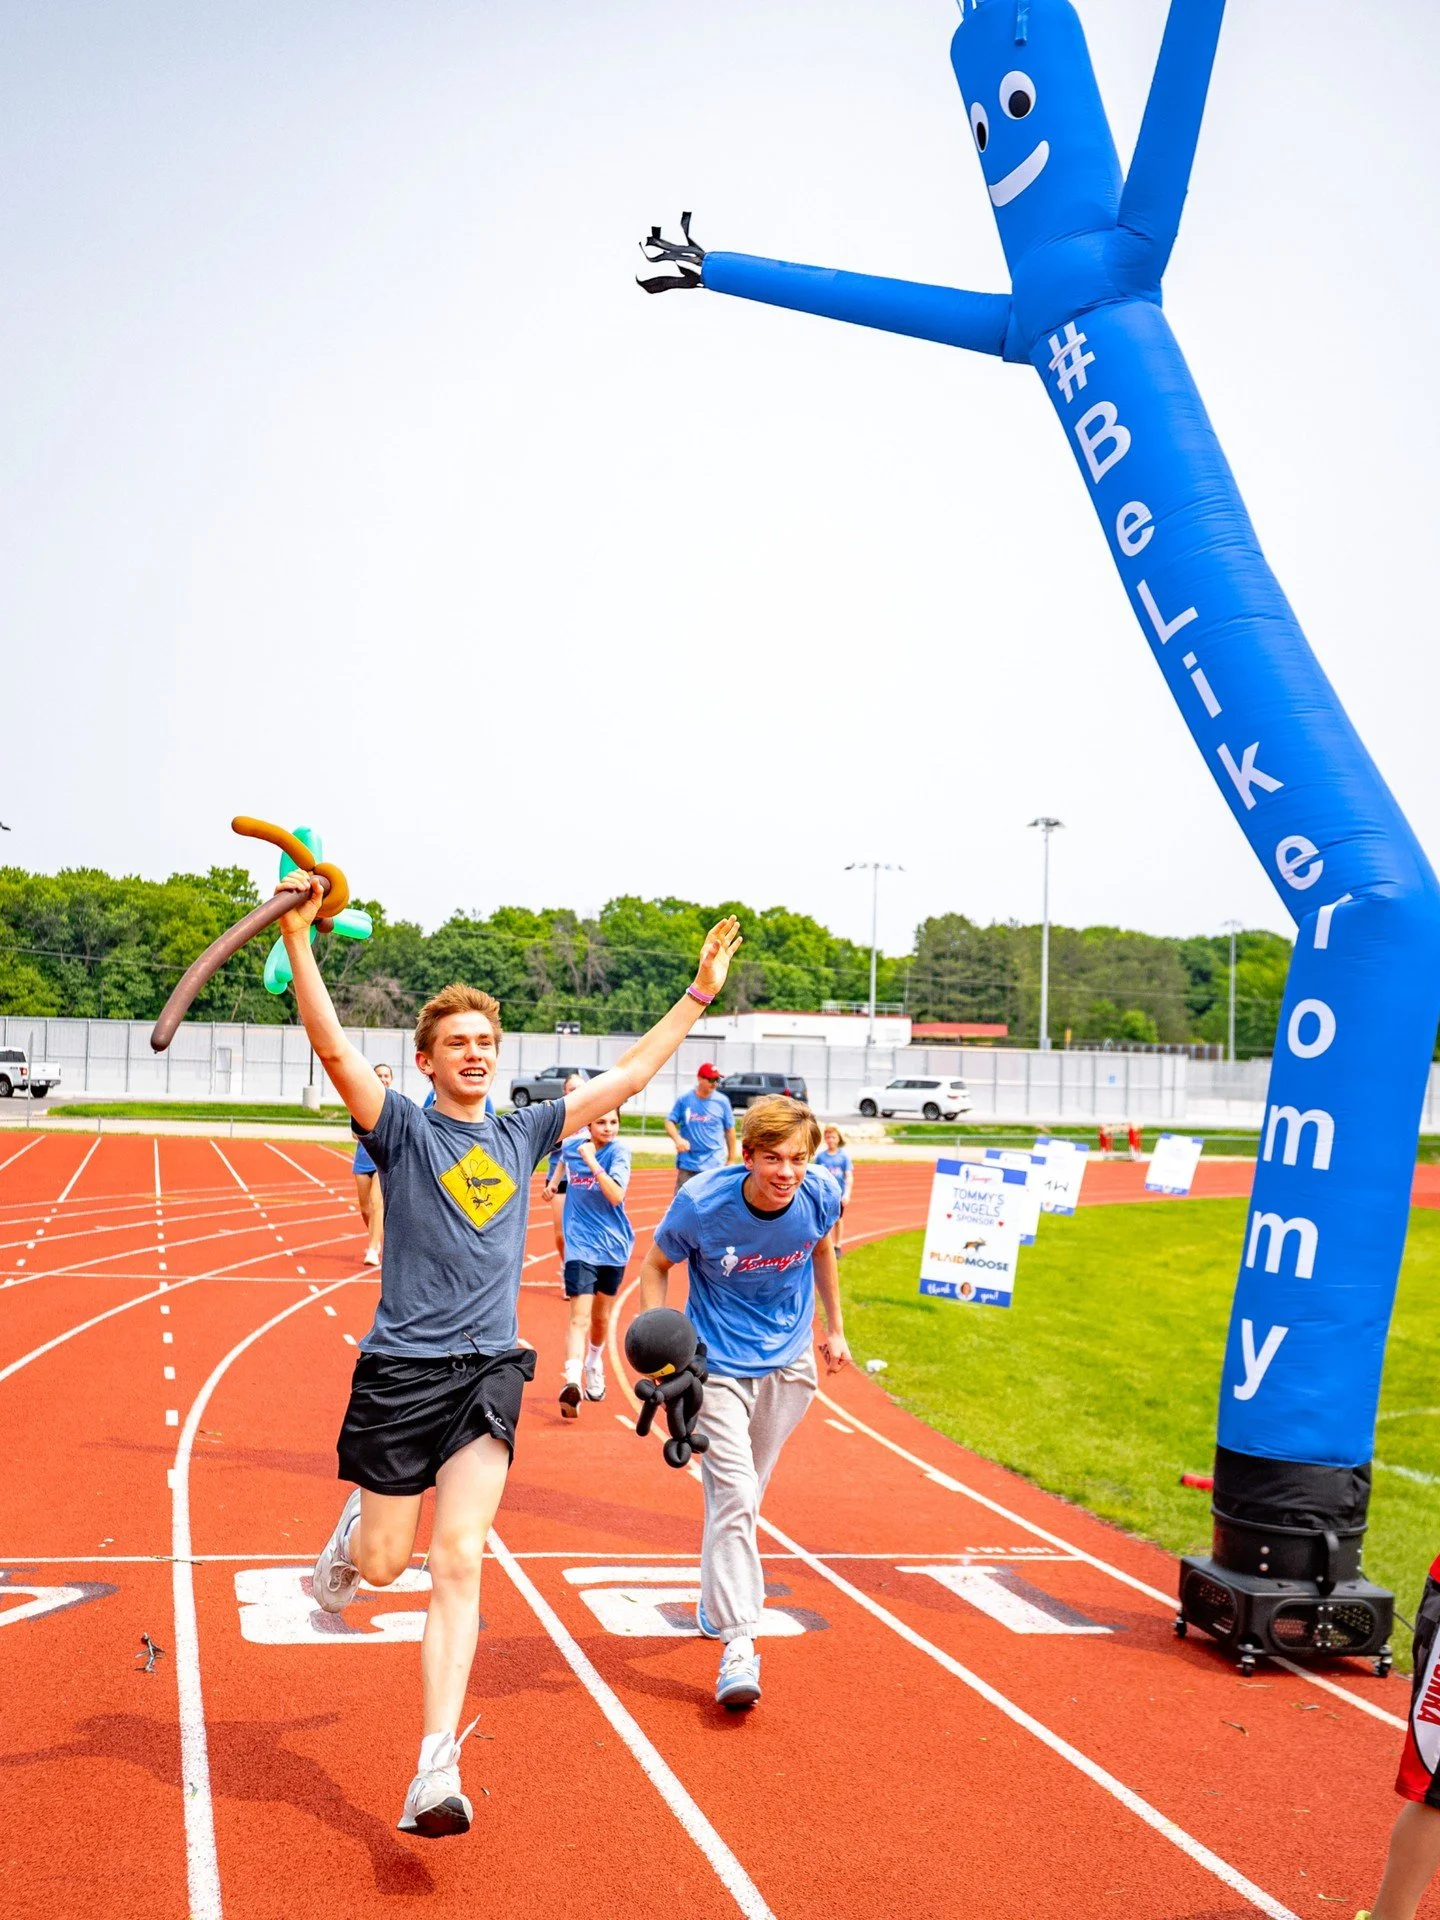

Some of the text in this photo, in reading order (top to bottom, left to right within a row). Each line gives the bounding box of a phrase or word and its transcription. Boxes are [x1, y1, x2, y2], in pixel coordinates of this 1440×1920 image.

[952, 1187, 1005, 1206] TOMMY'S
[952, 1201, 1001, 1218] ANGELS
[956, 1214, 995, 1226] SPONSOR
[738, 1250, 805, 1273] Tommy's
[929, 1251, 1009, 1272] PLAIDMOOSE
[926, 1282, 1000, 1304] thank you!
